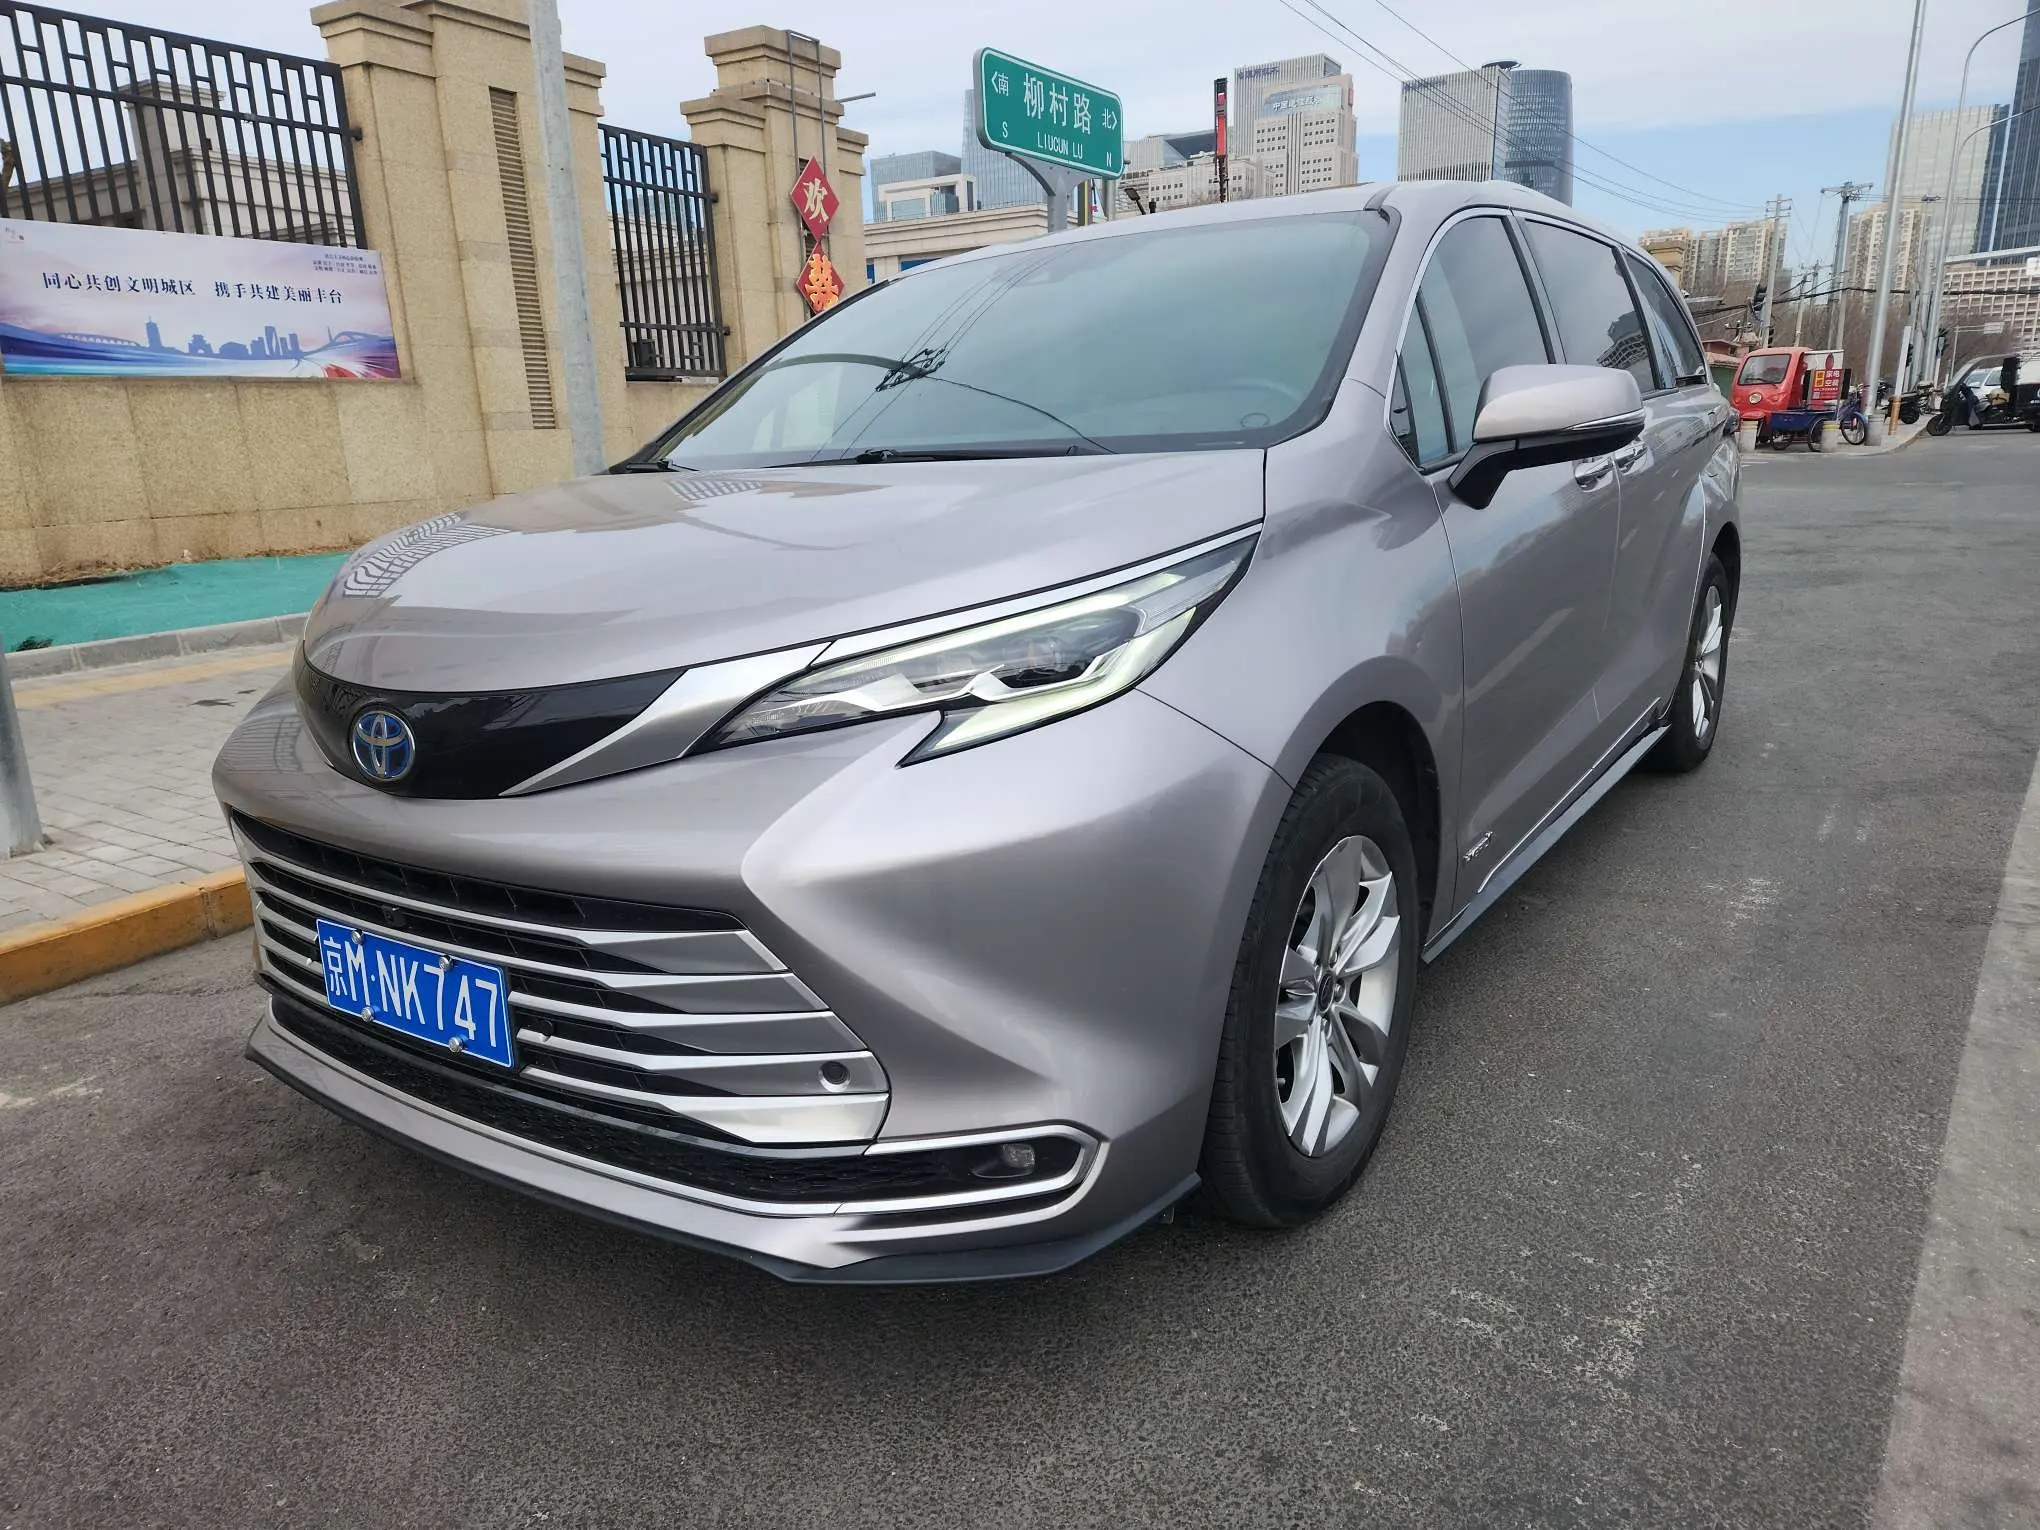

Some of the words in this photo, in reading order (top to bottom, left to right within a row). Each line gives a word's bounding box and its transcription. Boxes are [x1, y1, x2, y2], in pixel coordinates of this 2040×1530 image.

[997, 73, 1009, 97] 南
[1023, 73, 1092, 135] 柳村路
[1002, 121, 1009, 138] S
[1102, 108, 1112, 129] 北
[1037, 131, 1069, 156] LIUCUN
[1072, 142, 1083, 160] LU
[1106, 151, 1112, 167] N
[802, 178, 830, 223] 欢
[42, 272, 195, 296] 同心共创文明城区
[214, 281, 342, 304] 携手共建美丽丰台
